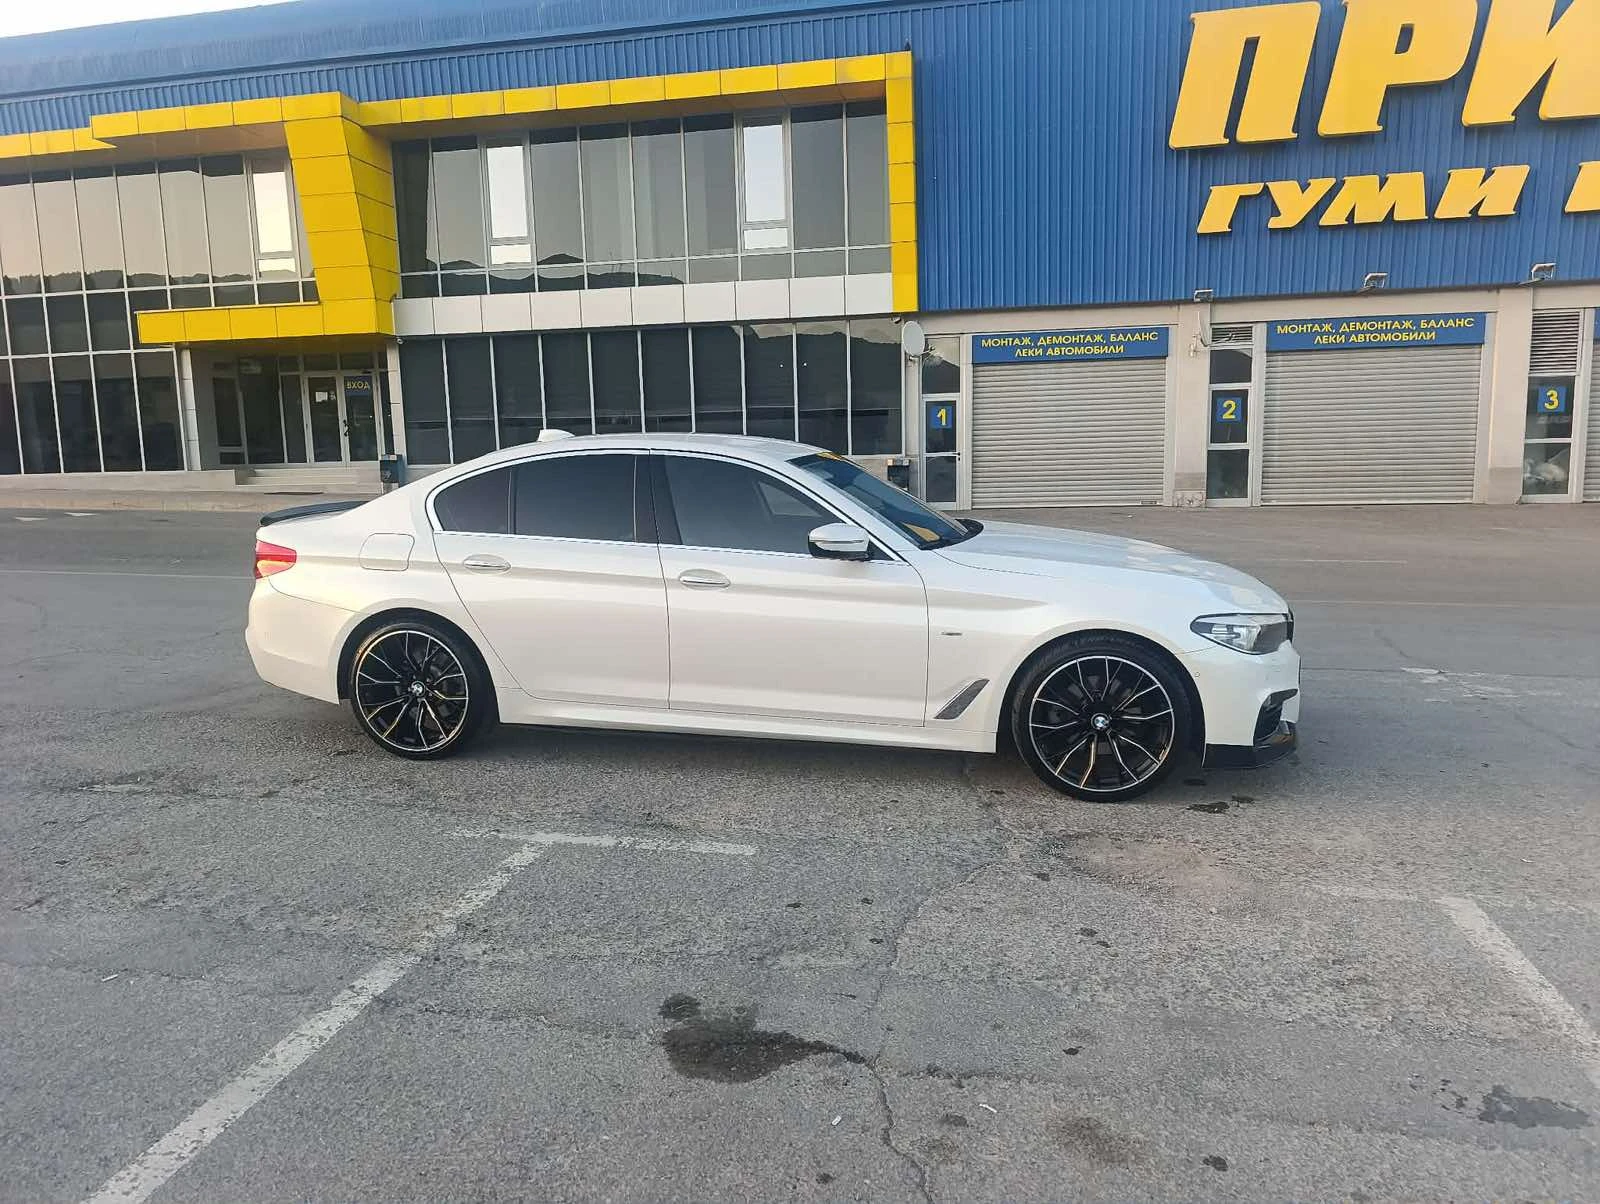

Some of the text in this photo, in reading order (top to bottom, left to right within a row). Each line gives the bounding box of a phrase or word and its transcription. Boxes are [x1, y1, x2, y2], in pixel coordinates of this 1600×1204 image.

[1197, 164, 1530, 233] ГУМИ
[1277, 317, 1475, 334] МОНТАЖ, ДЕМОНТАЖ, БАЛАНС
[981, 331, 1159, 348] МОНТАЖ, ДЕМОНТАЖ, БАЛАНС
[1314, 331, 1436, 345] ЛЕКИ АВТОМОБИЛИ
[1014, 345, 1124, 358] ЛЕКИ АВТОМОБИЛИ
[346, 380, 370, 389] ВХОД
[1544, 389, 1559, 410] 3
[937, 408, 947, 426] 1
[1222, 399, 1237, 420] 2
